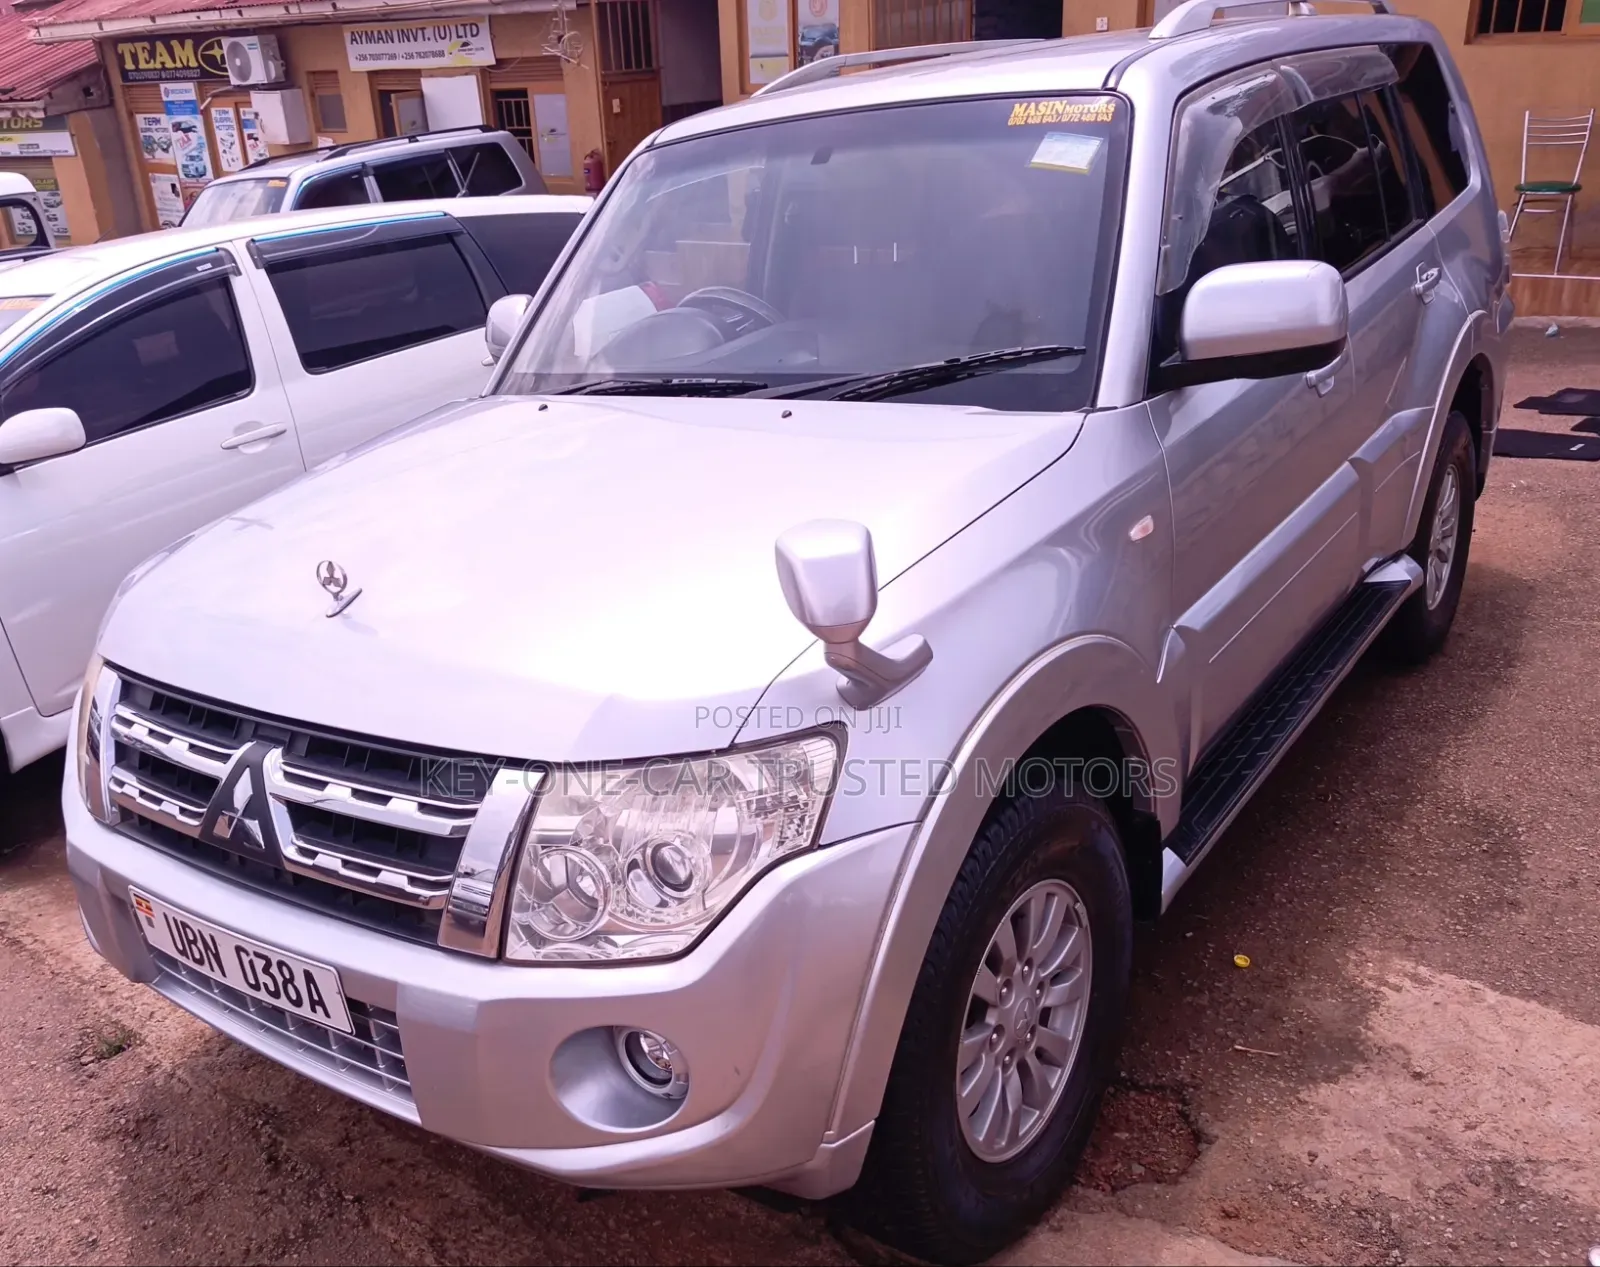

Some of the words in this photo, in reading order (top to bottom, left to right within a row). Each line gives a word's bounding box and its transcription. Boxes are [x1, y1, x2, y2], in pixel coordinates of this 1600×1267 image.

[350, 30, 394, 45] AYMAN
[397, 26, 430, 43] INVT.
[433, 24, 452, 42] (U)
[456, 22, 480, 39] LTD
[117, 39, 199, 70] TEAM
[1010, 100, 1067, 118] MASIN
[1064, 103, 1116, 115] MOTORS
[163, 911, 227, 979] UBN
[234, 944, 331, 1019] 038A
